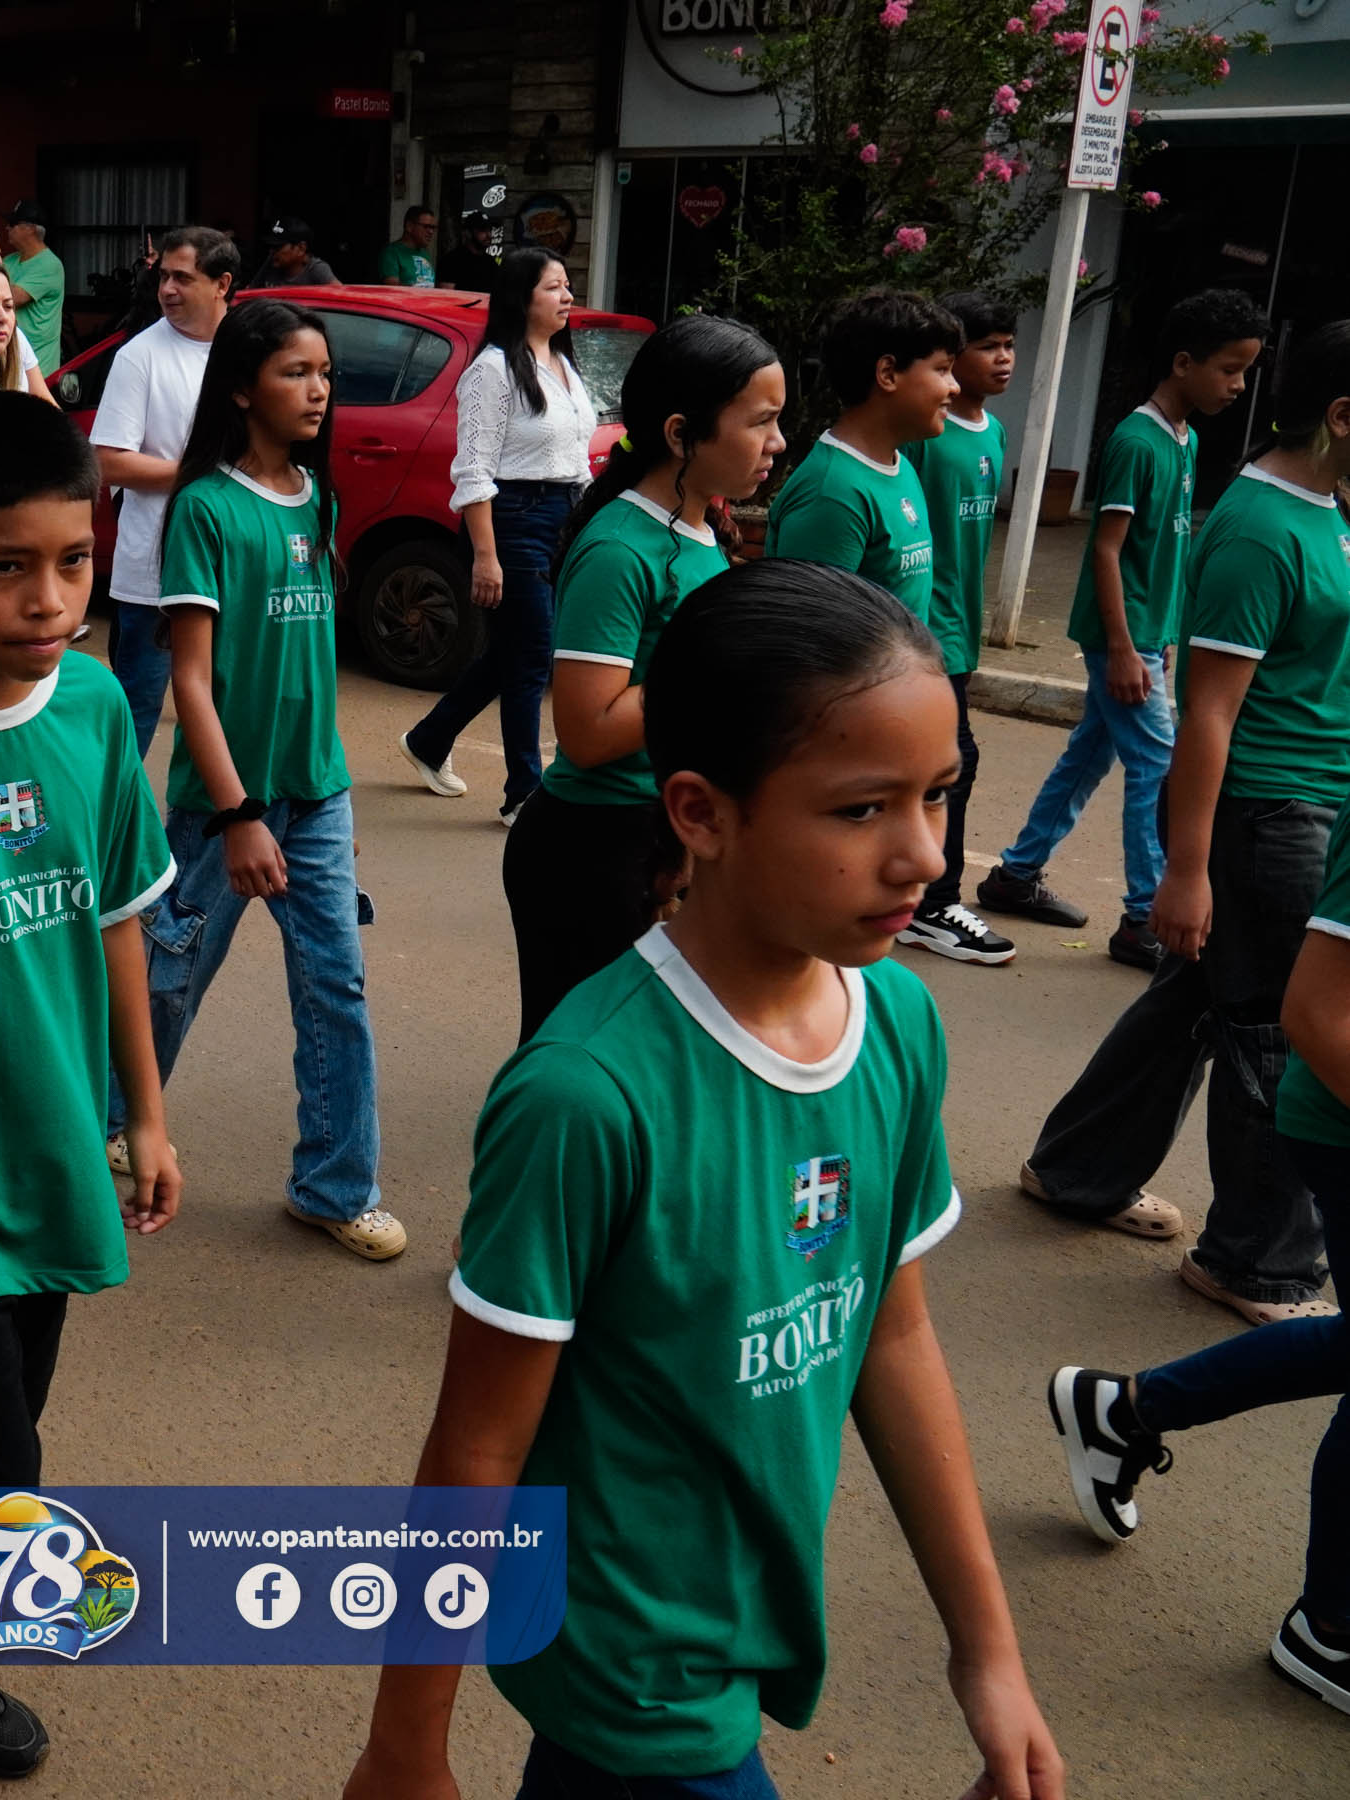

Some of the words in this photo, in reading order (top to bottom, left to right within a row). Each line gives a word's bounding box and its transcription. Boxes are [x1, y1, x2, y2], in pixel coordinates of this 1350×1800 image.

[334, 96, 361, 110] Pastel
[363, 97, 390, 112] Bonito
[1085, 113, 1112, 126] EMBARQUE
[1081, 125, 1118, 139] DESEMBARQUE
[1089, 140, 1110, 152] MINUTOS
[266, 592, 333, 616] BONITO
[4, 836, 34, 848] BONITO
[18, 866, 70, 885] MUNICIPAL
[72, 866, 87, 876] DE
[45, 916, 60, 929] DO
[60, 911, 79, 923] SUL
[735, 1276, 864, 1383] BONITO
[751, 1376, 795, 1399] MATO
